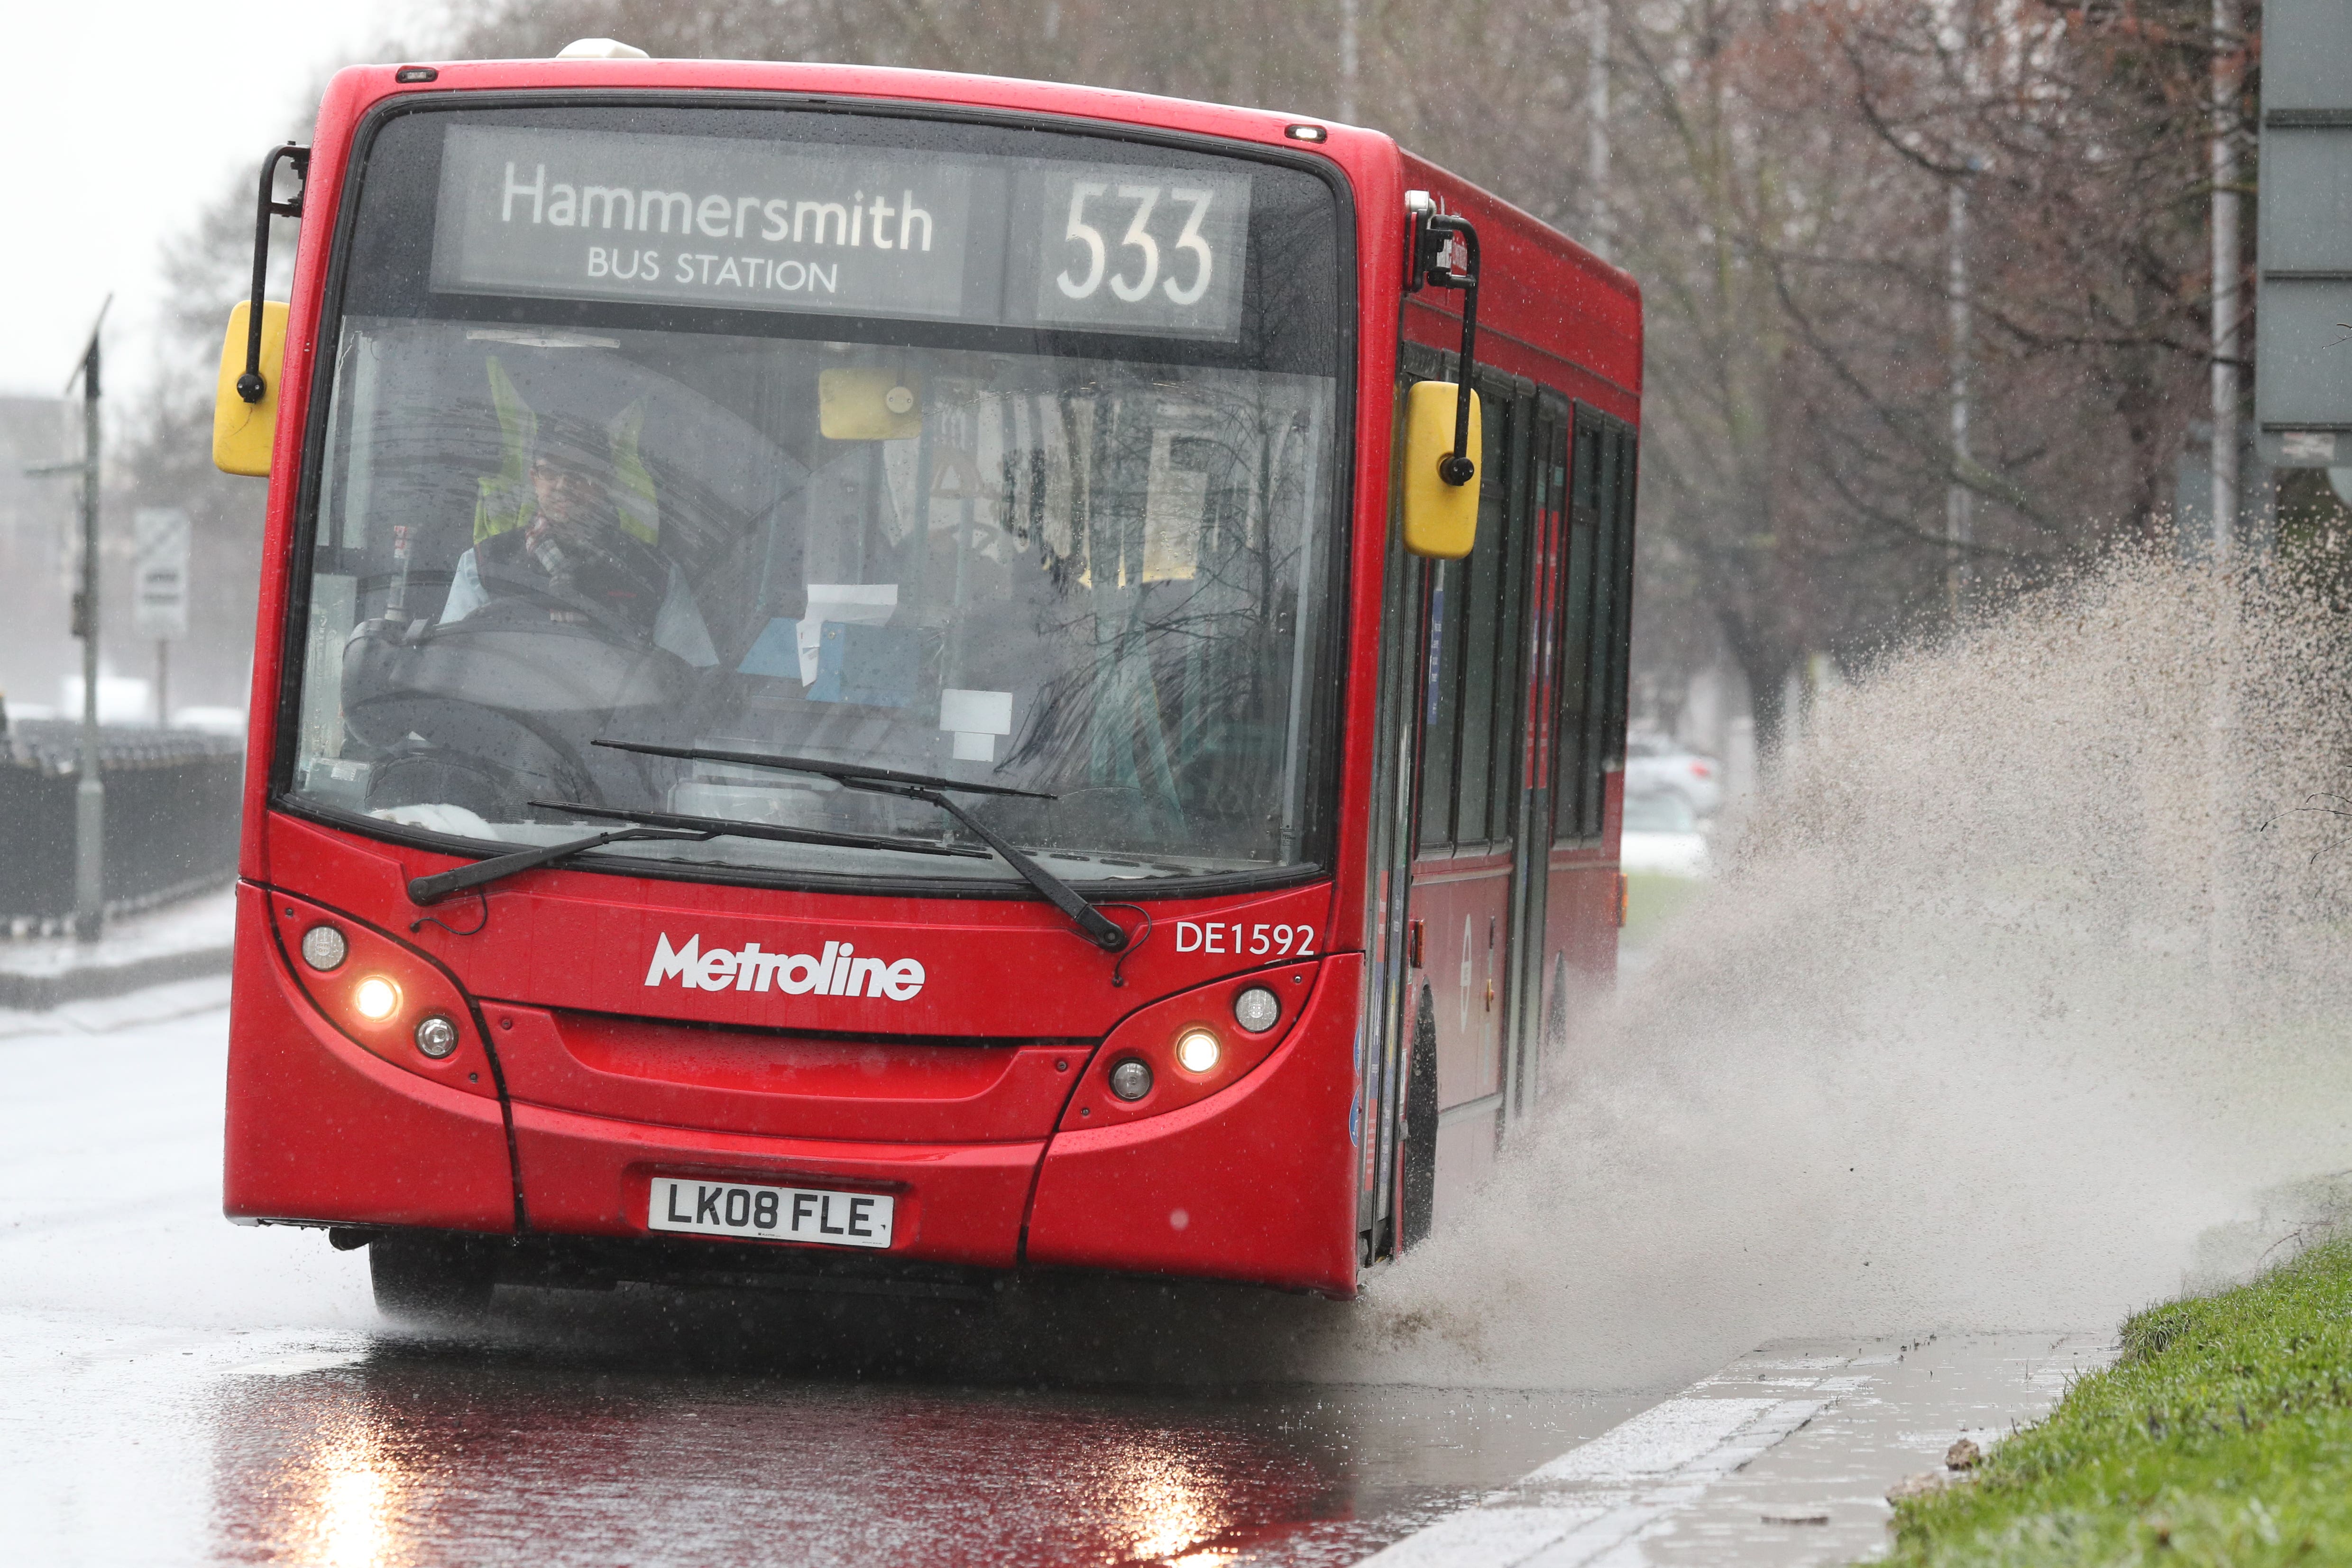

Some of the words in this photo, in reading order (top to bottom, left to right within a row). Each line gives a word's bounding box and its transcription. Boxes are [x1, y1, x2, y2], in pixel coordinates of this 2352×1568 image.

[500, 161, 935, 251] Hammersmith
[587, 245, 660, 282] BUS
[674, 251, 839, 296] STATION
[1056, 183, 1214, 305] 533
[644, 931, 926, 1001] Metroline
[1176, 921, 1314, 956] DE1592
[667, 1183, 780, 1230] LK08
[791, 1192, 875, 1238] FLE
